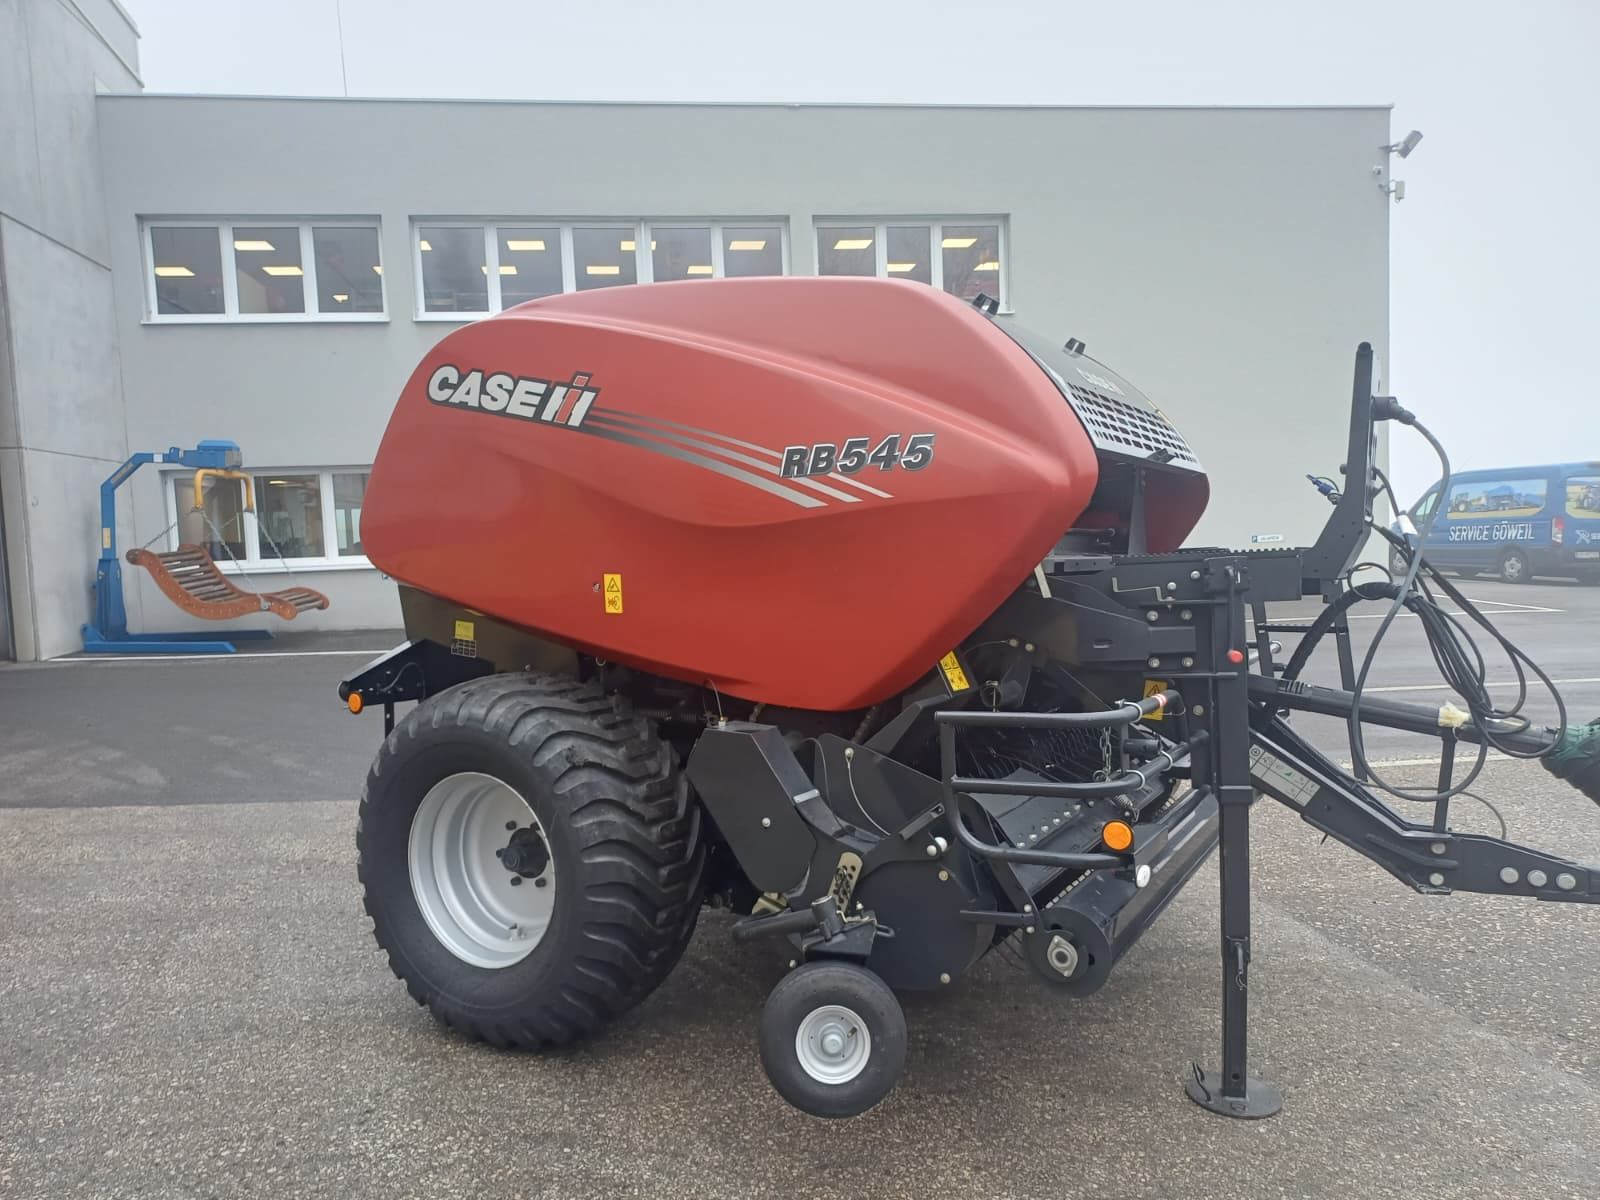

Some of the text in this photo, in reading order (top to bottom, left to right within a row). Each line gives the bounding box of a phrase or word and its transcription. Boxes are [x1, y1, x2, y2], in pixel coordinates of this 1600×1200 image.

[428, 365, 547, 418] CASE
[1449, 521, 1535, 541] SERVICE GÖWEIL
